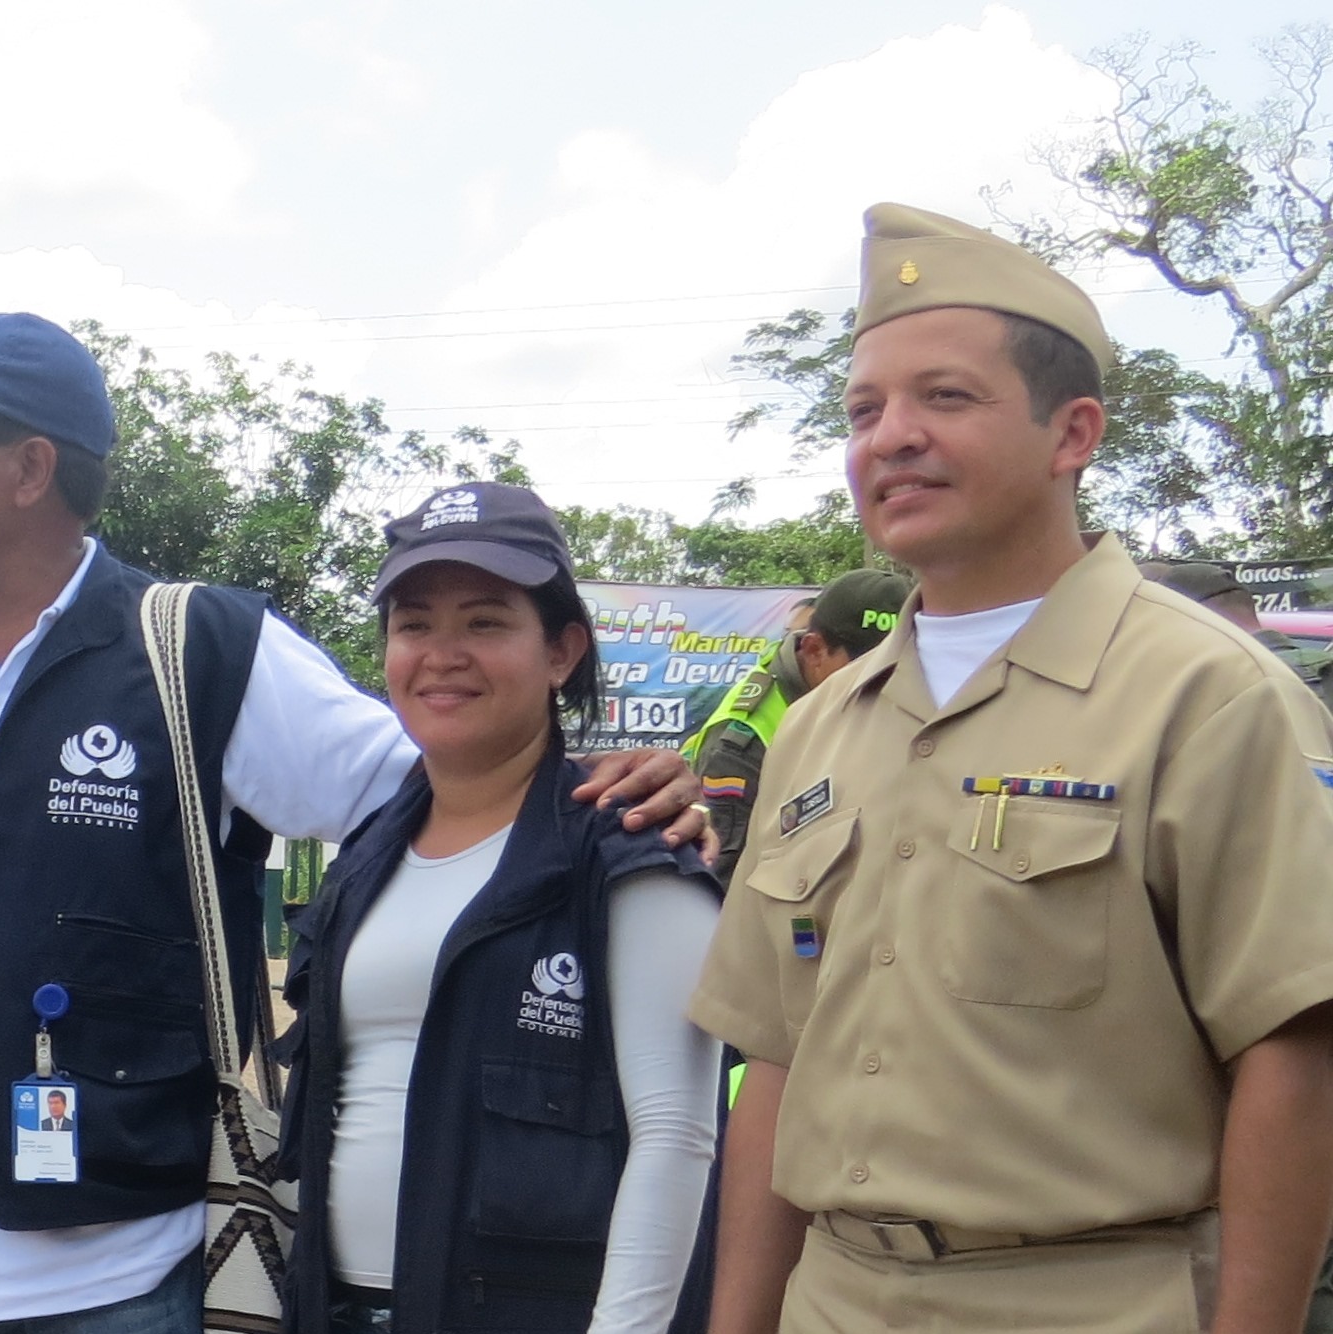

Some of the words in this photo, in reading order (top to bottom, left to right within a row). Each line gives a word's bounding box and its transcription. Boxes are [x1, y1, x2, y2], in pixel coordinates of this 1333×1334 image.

[670, 631, 768, 654] Marina
[631, 702, 681, 727] 101
[616, 738, 643, 748] 2014
[653, 738, 679, 749] 2018
[49, 778, 139, 801] Defensoría
[48, 795, 75, 811] del
[80, 797, 138, 818] Pueblo
[51, 815, 134, 830] COLOMBIA
[520, 1005, 542, 1021] del
